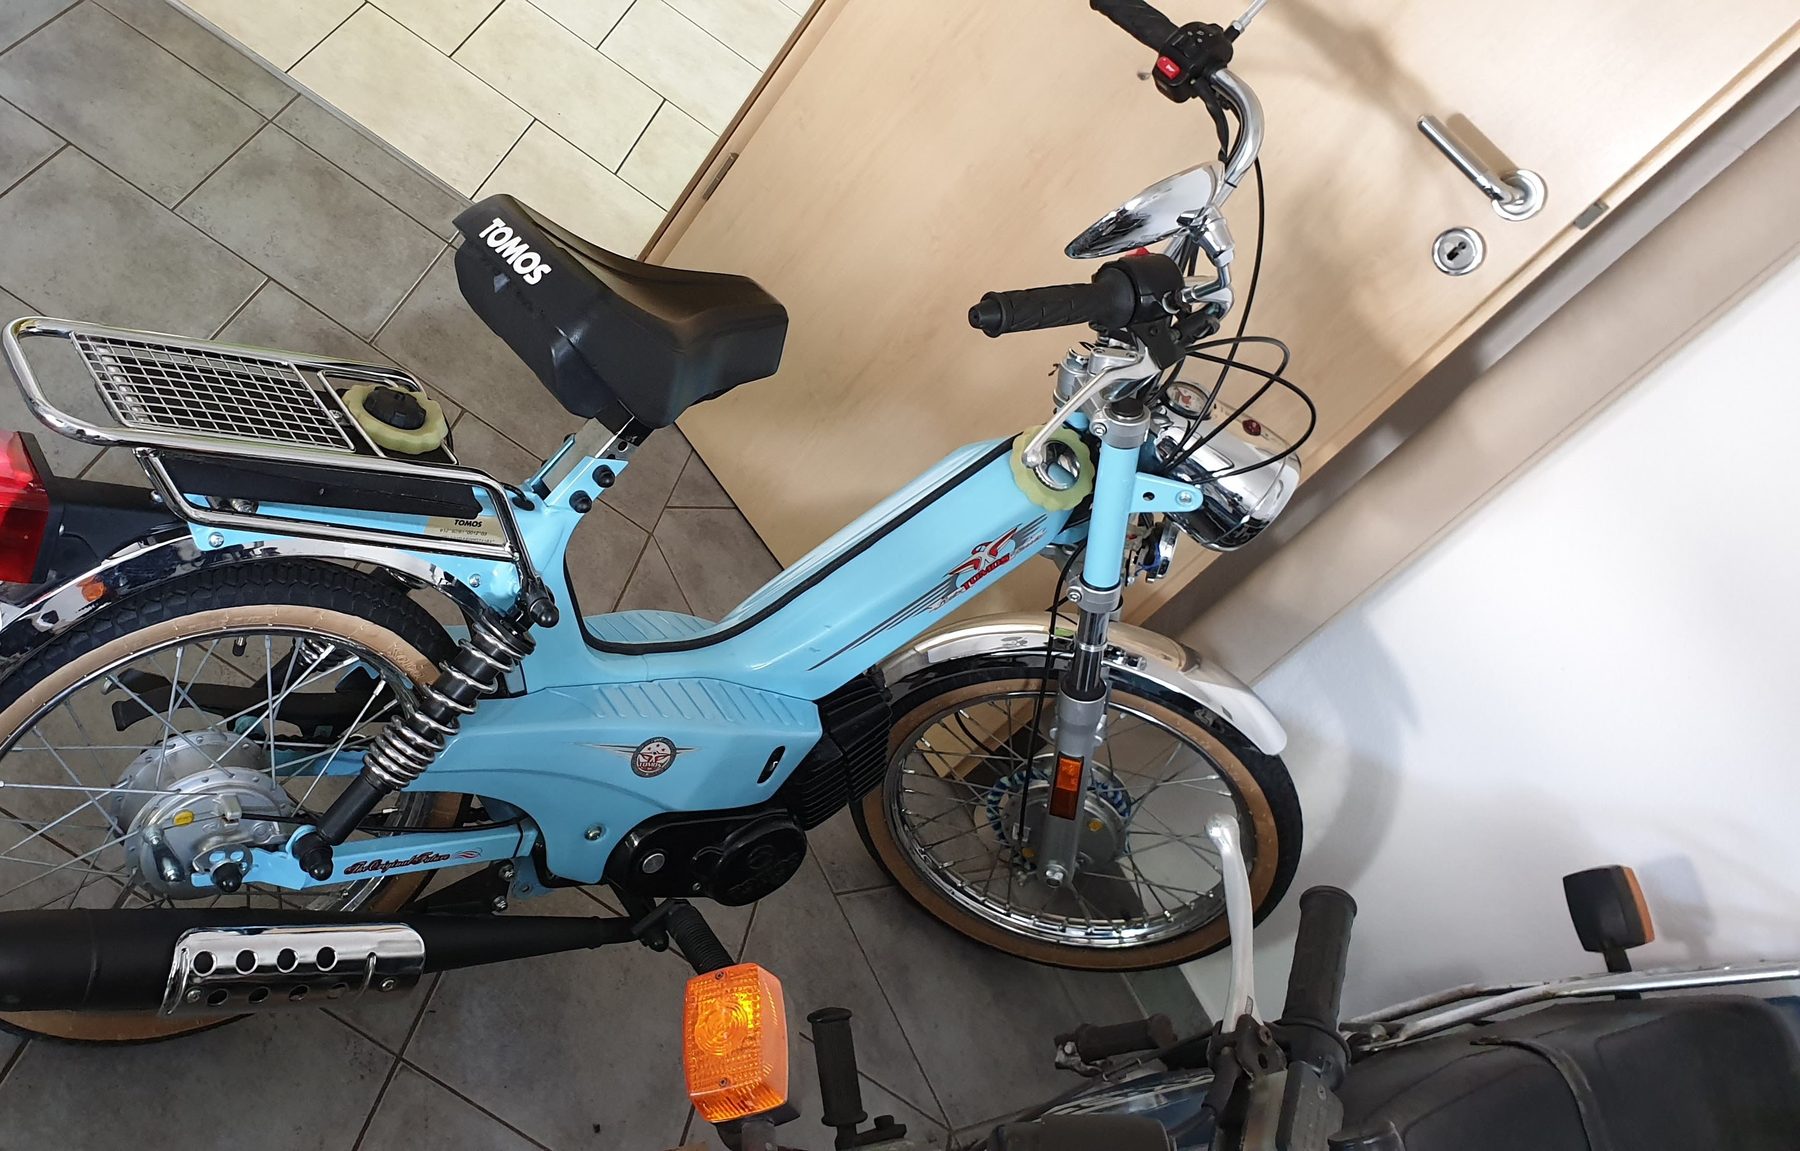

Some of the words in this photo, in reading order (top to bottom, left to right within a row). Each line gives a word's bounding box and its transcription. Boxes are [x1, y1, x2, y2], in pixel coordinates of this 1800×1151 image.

[478, 217, 552, 285] TOMOS
[454, 519, 482, 528] TOMOS
[961, 553, 1011, 591] TOMOS
